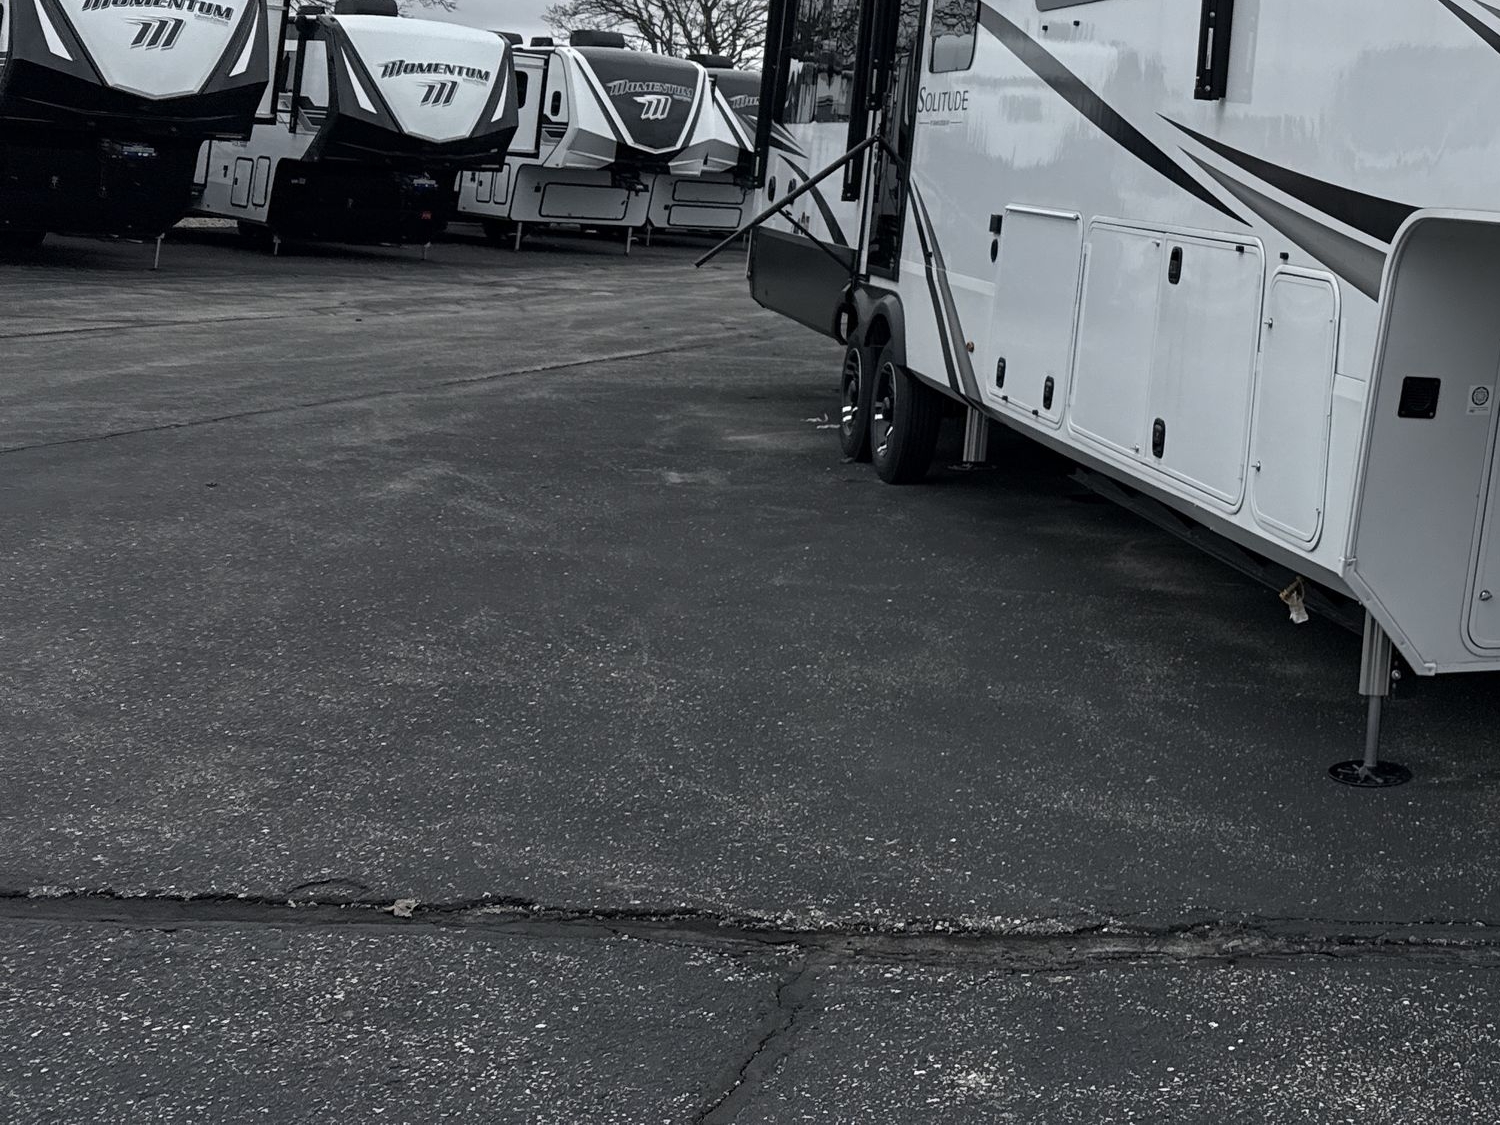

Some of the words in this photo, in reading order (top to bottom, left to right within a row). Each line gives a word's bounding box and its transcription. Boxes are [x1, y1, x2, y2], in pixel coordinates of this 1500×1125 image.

[378, 59, 491, 82] MOMENTUM
[605, 78, 695, 98] MOMENTUM
[917, 86, 969, 114] SOLITUDE
